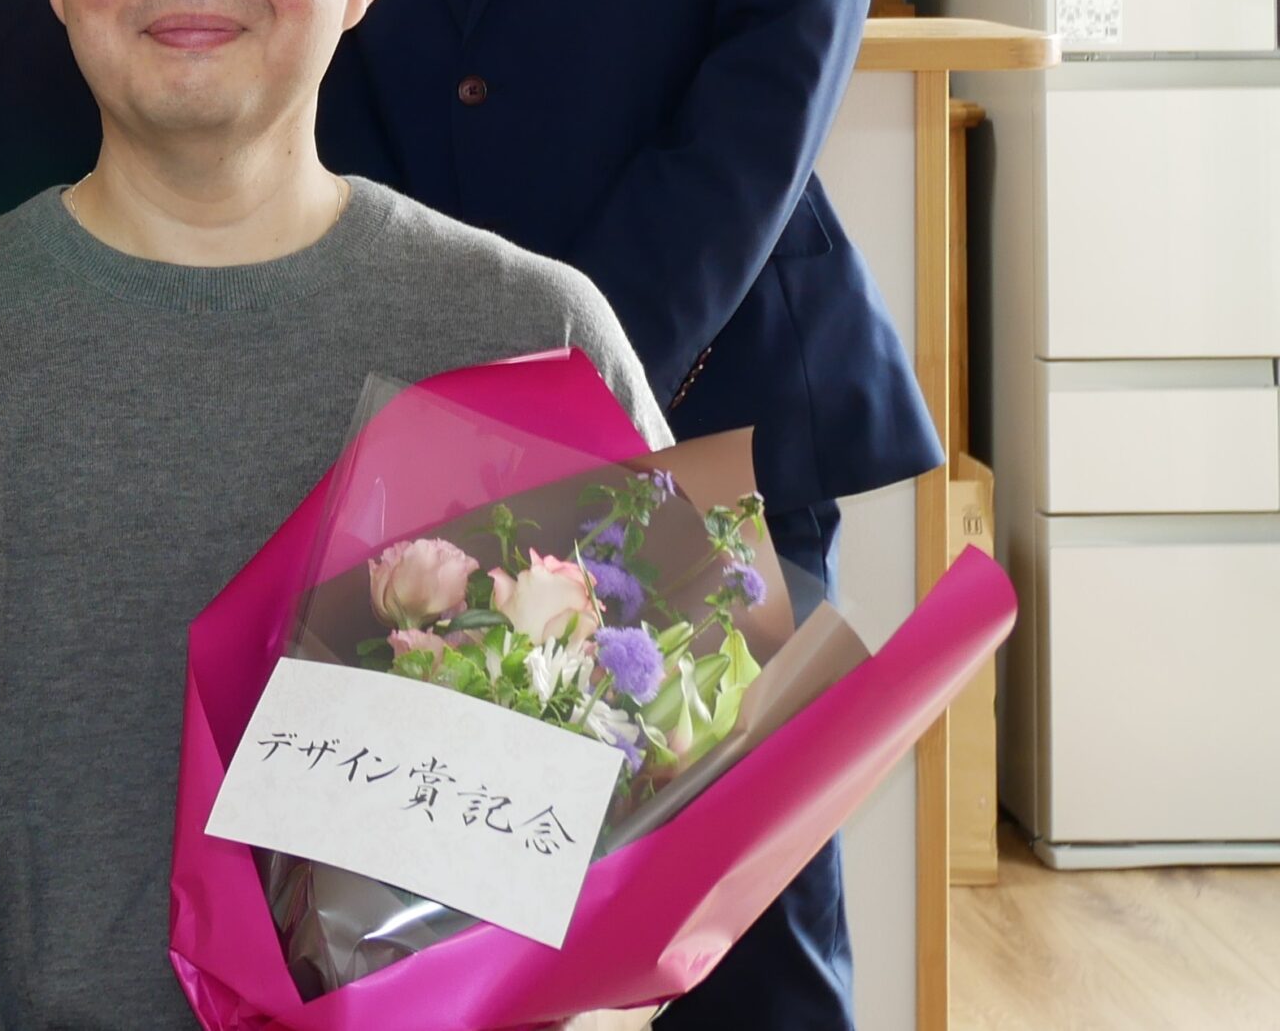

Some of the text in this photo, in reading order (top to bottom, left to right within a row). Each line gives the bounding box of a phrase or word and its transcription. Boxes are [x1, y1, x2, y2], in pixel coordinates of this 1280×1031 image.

[257, 732, 576, 855] デザイン賞記念
